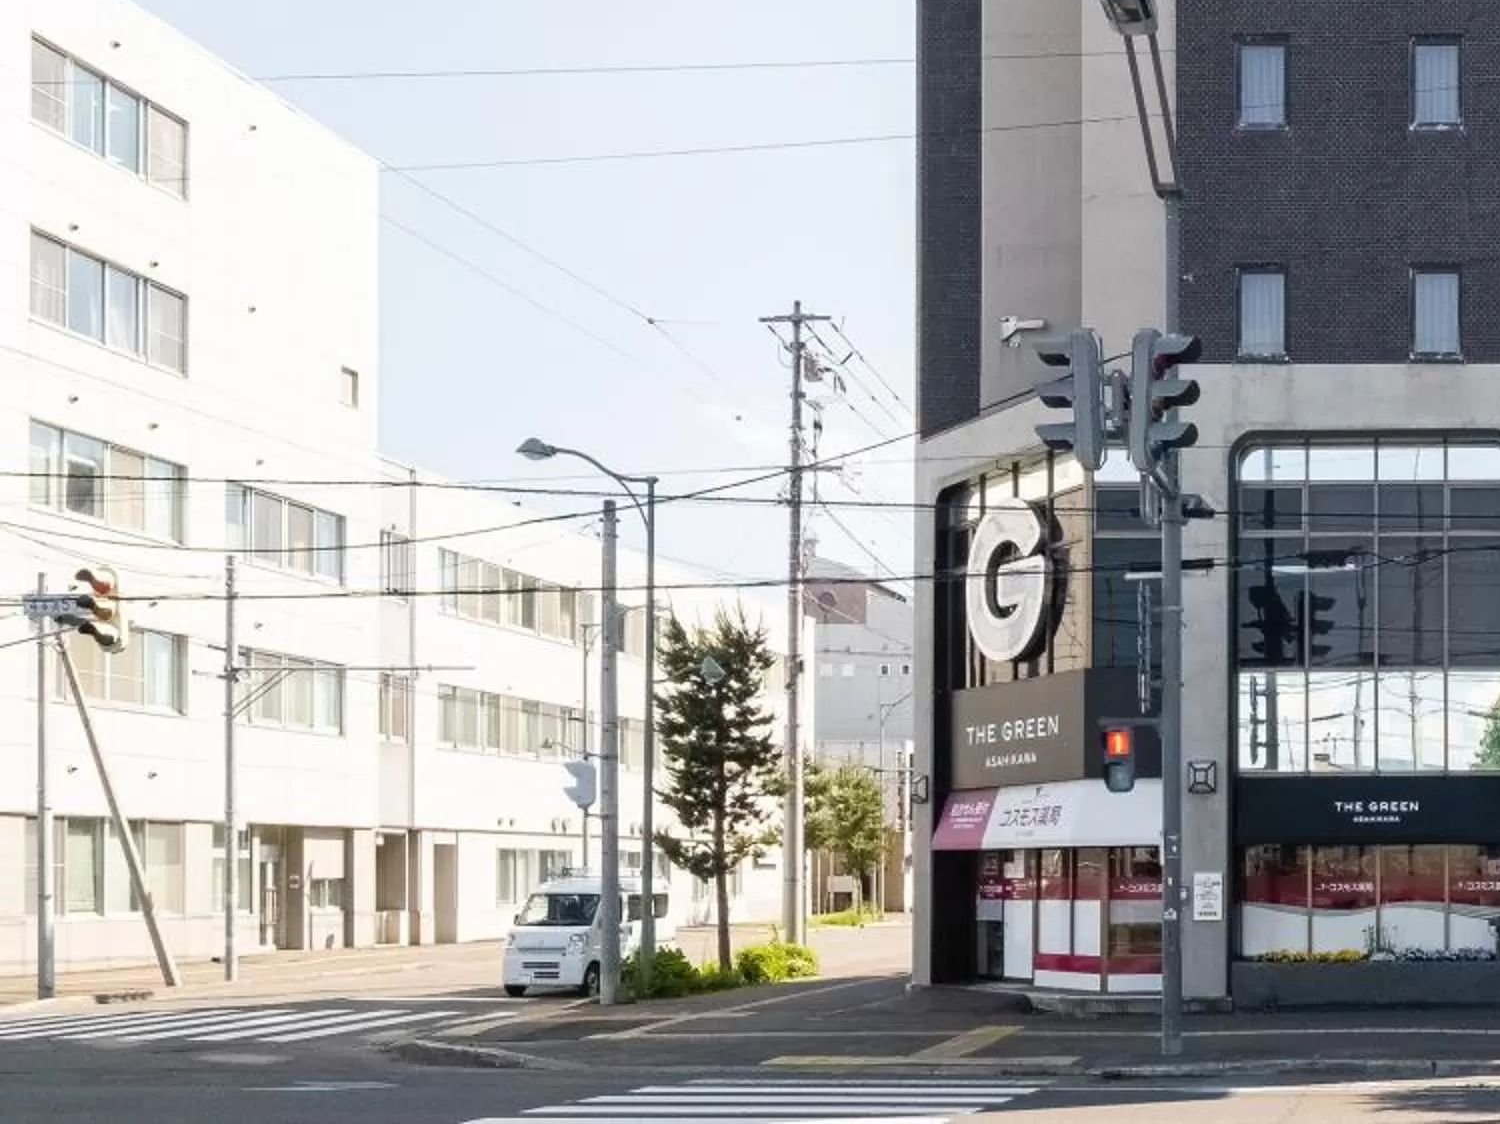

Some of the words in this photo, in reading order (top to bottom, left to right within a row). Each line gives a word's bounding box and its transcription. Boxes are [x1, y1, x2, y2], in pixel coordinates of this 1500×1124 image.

[966, 496, 1048, 662] G
[965, 723, 997, 746] THE
[1001, 715, 1060, 742] GREEN
[1334, 800, 1364, 813] THE
[1368, 800, 1420, 813] GREEN
